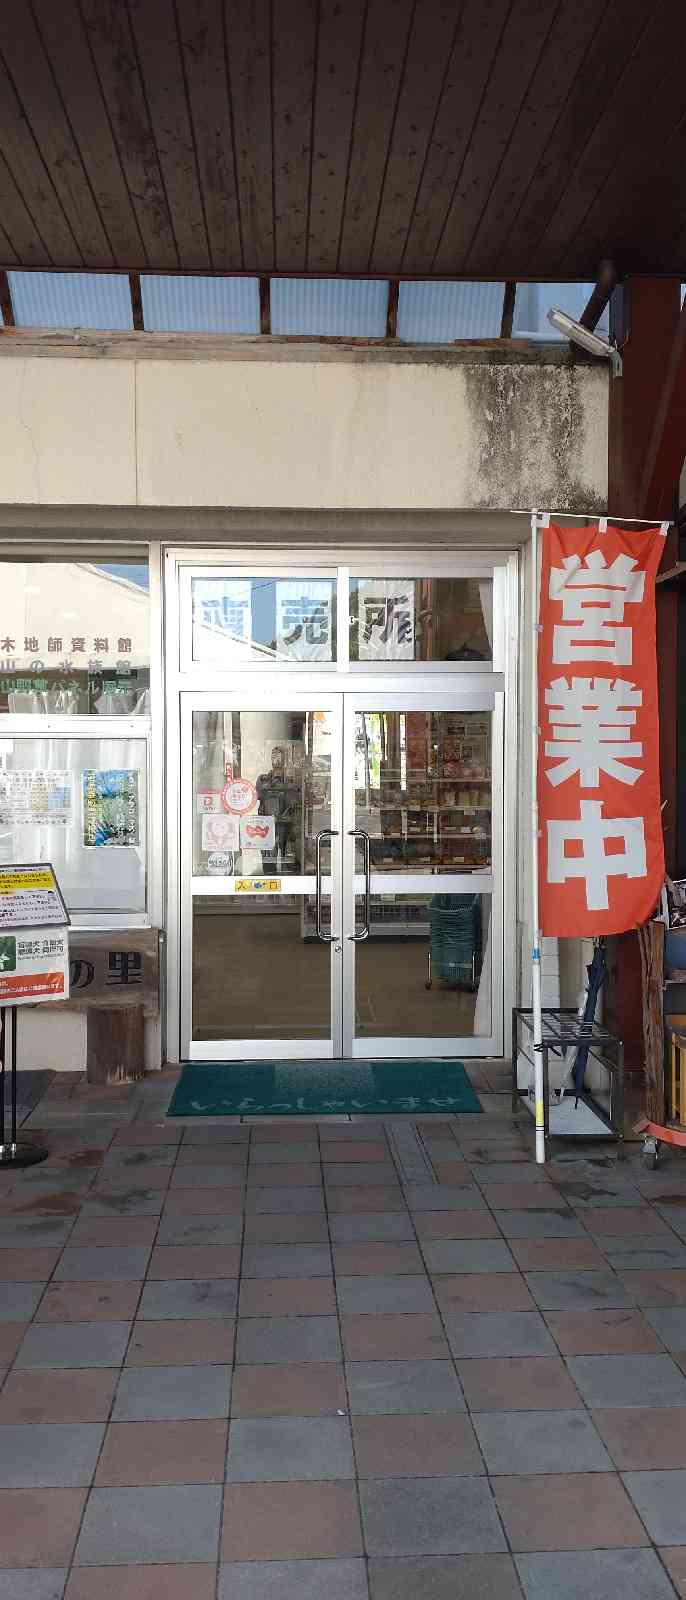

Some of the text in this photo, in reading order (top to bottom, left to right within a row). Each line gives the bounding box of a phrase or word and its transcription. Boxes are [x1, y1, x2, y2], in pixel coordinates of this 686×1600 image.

[1, 637, 133, 652] 木地師資料館
[546, 549, 648, 911] 営業中
[70, 951, 142, 988] の里
